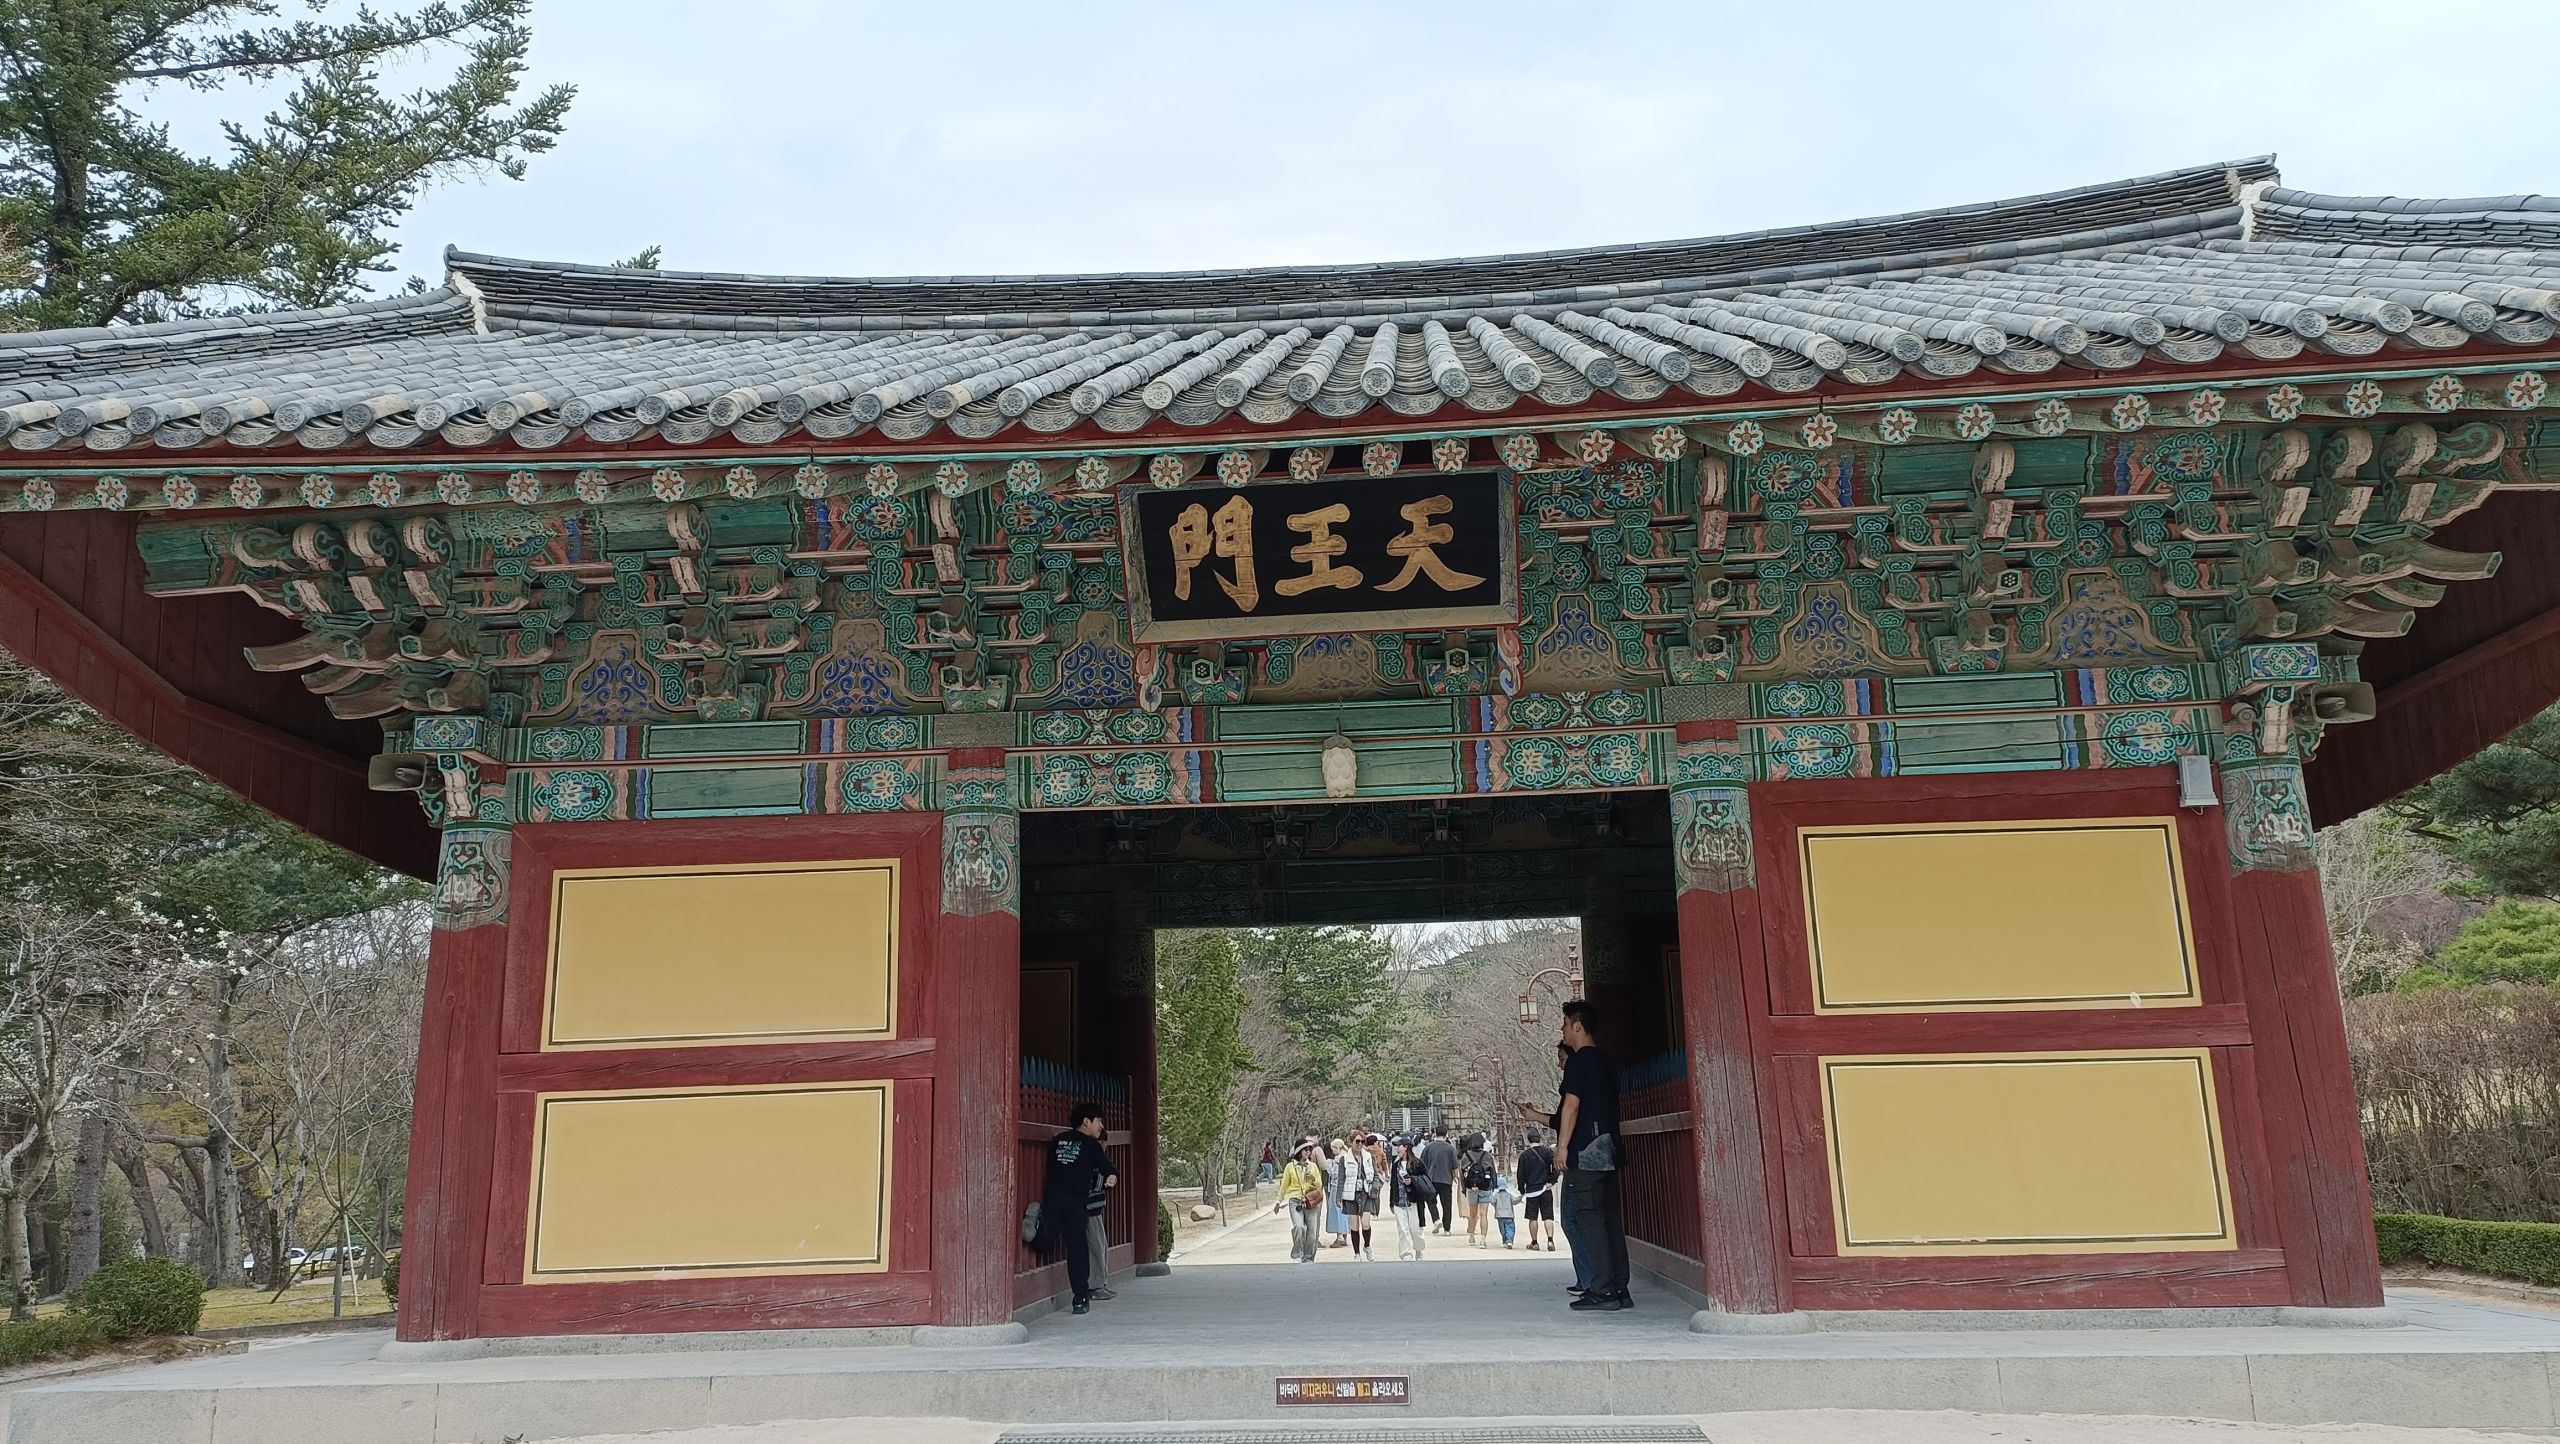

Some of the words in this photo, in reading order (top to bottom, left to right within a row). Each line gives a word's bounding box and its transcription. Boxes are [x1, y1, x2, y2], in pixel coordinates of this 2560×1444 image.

[1279, 1383, 1300, 1397] 바닥이
[1301, 1382, 1335, 1397] 미끄러우니
[1336, 1381, 1356, 1397] 신발을
[1357, 1382, 1370, 1397] 털고
[1372, 1381, 1405, 1397] 올라오세요
